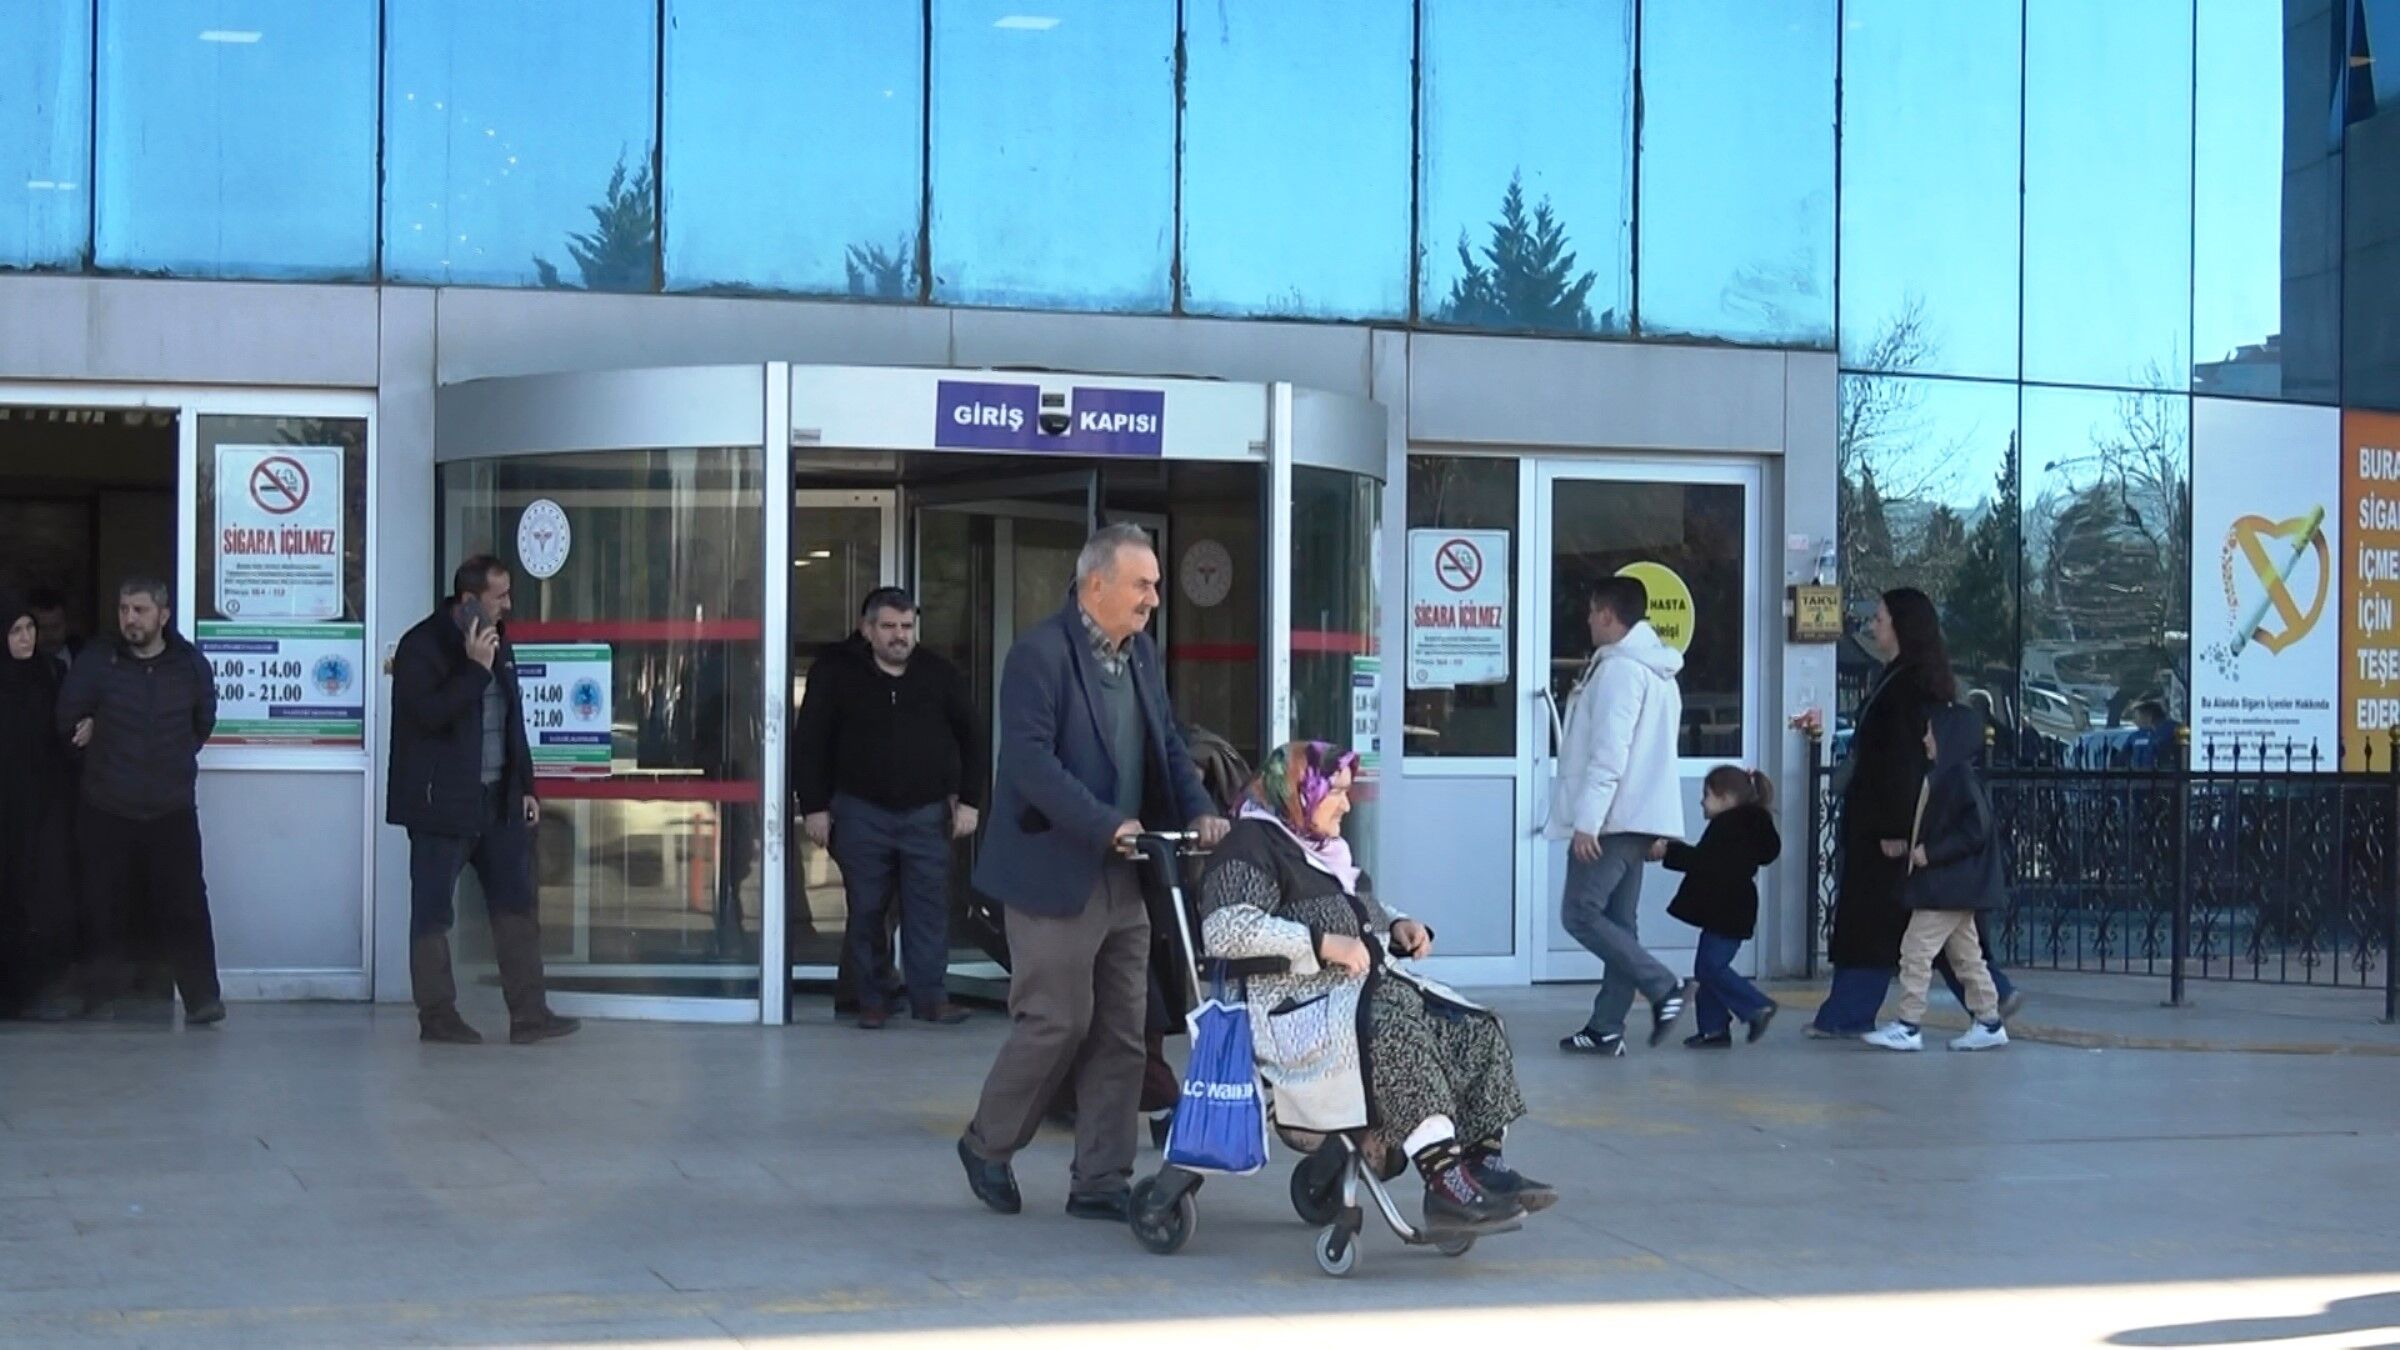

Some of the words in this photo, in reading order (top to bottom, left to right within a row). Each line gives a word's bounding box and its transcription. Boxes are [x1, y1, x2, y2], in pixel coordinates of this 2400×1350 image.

[953, 401, 1025, 432] GİRİŞ
[1080, 411, 1157, 433] KAPISI
[2359, 490, 2400, 531] SİGA
[223, 522, 277, 555] SİGARA
[280, 522, 335, 560] İÇİLMEZ
[1650, 598, 1686, 610] HASTA
[1414, 599, 1456, 628] SİGARA
[1458, 599, 1502, 632] İÇİLMEZ
[2358, 591, 2392, 638] İÇİN
[213, 659, 244, 678] 1.00
[260, 660, 302, 678] 14.00
[260, 683, 302, 701] 21.00
[533, 685, 563, 703] 14.00
[533, 709, 563, 728] 21.00
[1183, 1078, 1205, 1098] LC
